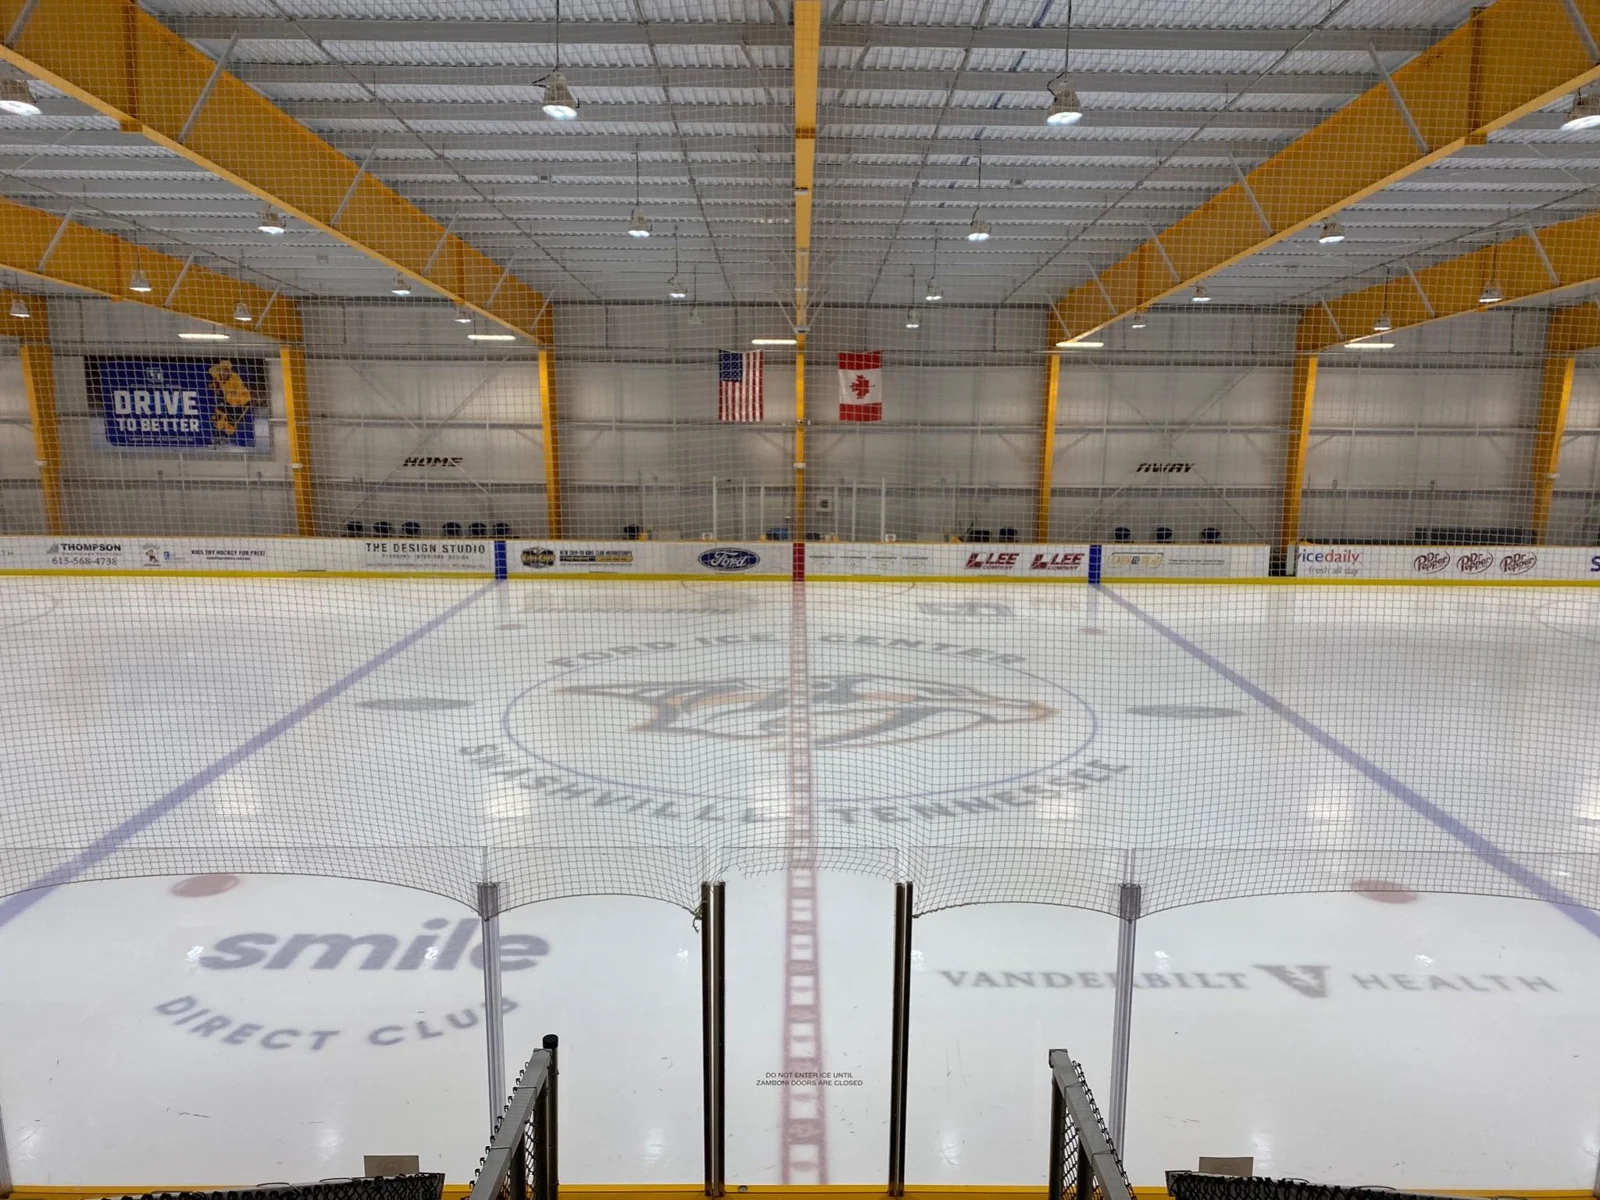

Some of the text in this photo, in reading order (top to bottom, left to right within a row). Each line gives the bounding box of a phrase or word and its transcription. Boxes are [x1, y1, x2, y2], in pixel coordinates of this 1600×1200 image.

[114, 390, 199, 415] DRIVE
[117, 418, 199, 432] TO BETTER
[403, 456, 463, 467] HOME
[1135, 463, 1195, 473] AWAY
[60, 543, 122, 552] THOMPSON
[366, 542, 486, 554] THE DESIGN STUDIO
[51, 557, 118, 565] 615-568-4738
[710, 551, 748, 567] Ford
[985, 553, 1019, 564] LEE
[1050, 553, 1085, 565] LEE
[1427, 552, 1439, 561] Dr
[1470, 553, 1482, 562] Dr
[1513, 554, 1525, 562] Dr
[1417, 556, 1447, 571] Pepper
[1460, 556, 1490, 572] Pepper
[1503, 557, 1533, 572] Pepper
[1309, 566, 1330, 574] fresh
[1344, 567, 1359, 576] day
[828, 760, 1130, 823] TENNESSEE
[202, 918, 550, 971] smile
[1349, 973, 1558, 992] HEALTH
[156, 996, 340, 1050] DIRECT
